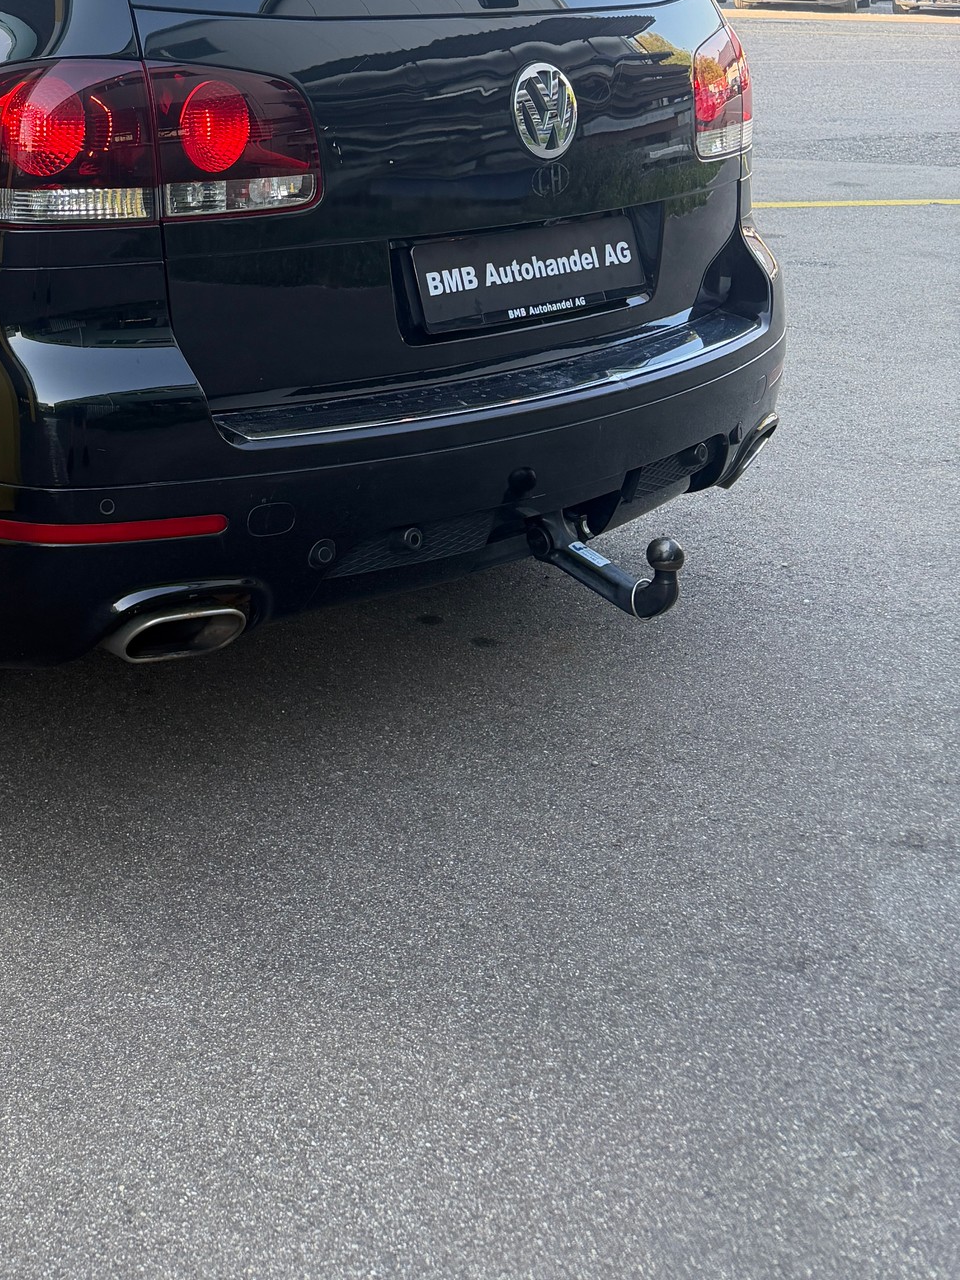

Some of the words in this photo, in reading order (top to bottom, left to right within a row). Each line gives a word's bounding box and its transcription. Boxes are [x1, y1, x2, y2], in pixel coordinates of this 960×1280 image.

[425, 266, 479, 296] BMB
[485, 246, 600, 287] Autohandel
[604, 241, 632, 267] AG
[508, 306, 527, 319] BMB
[529, 298, 574, 316] Autohandel
[574, 296, 586, 307] AG
